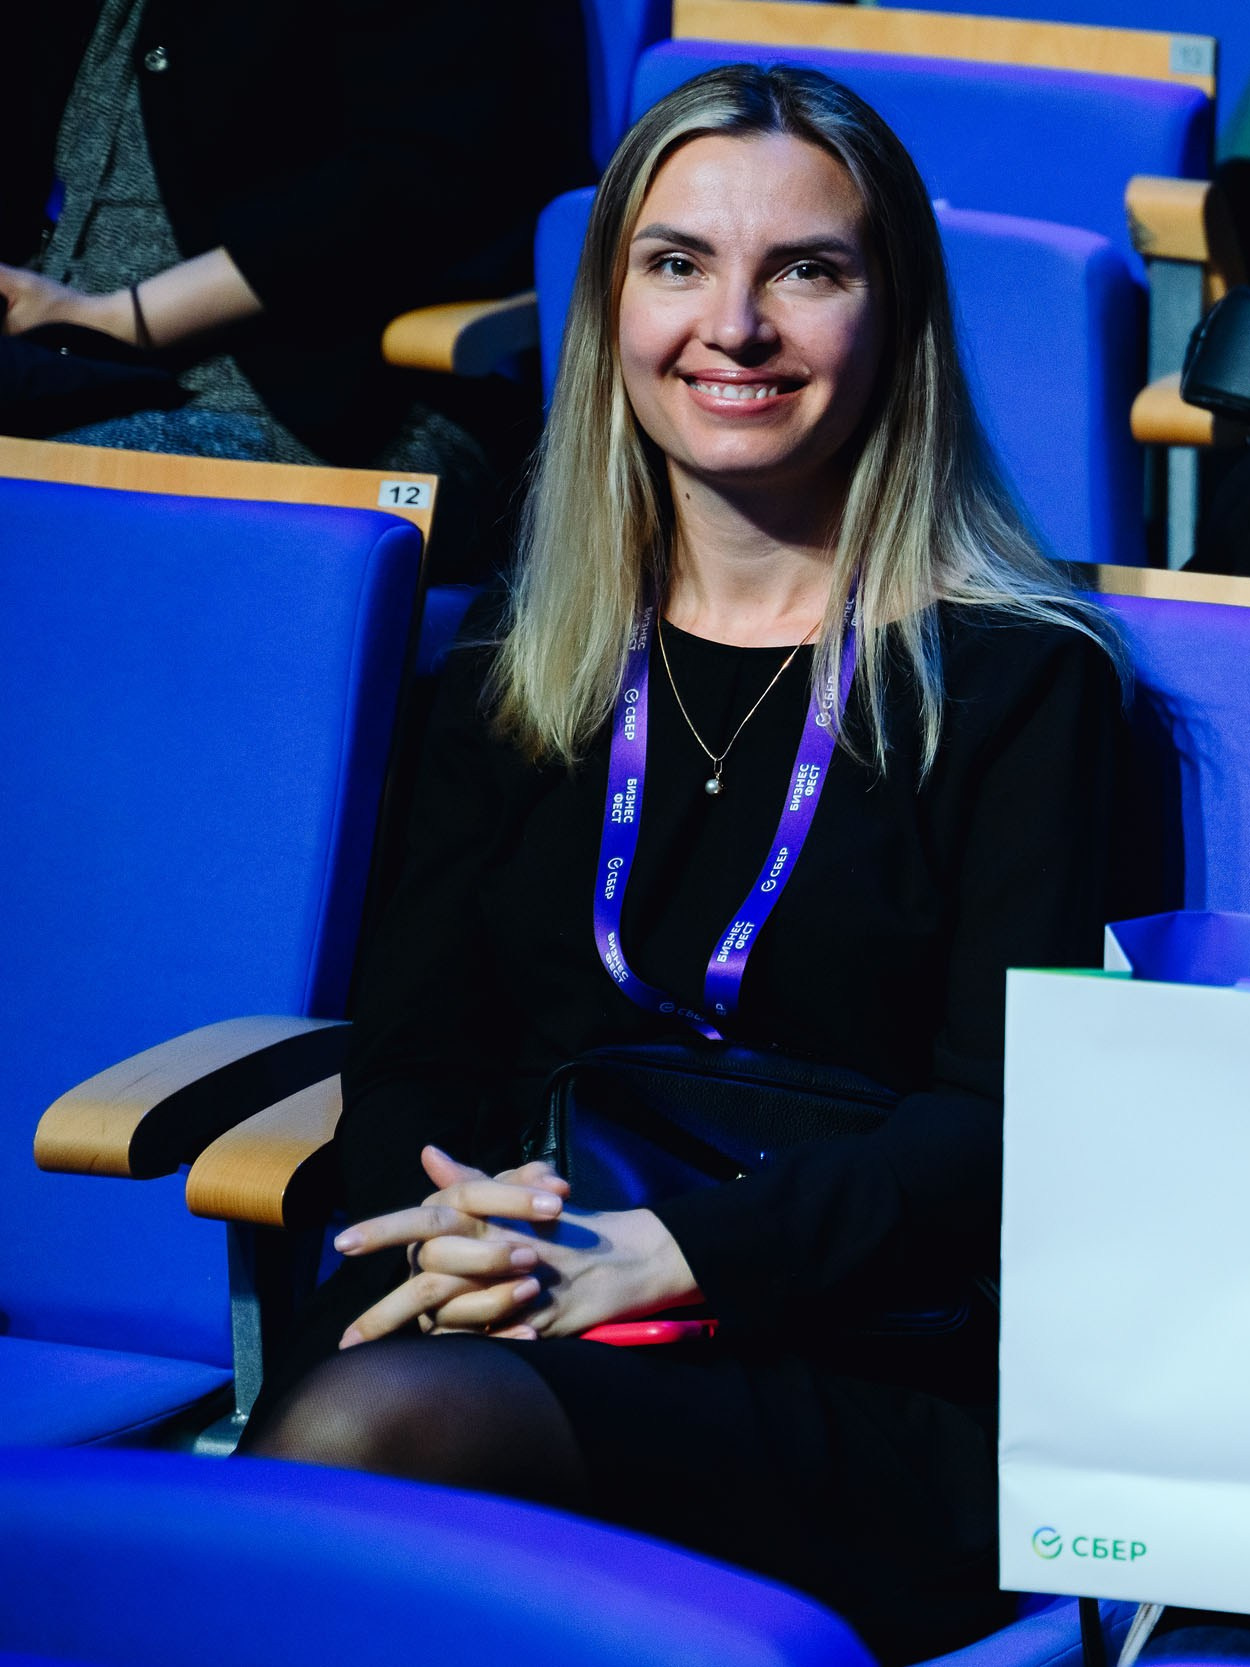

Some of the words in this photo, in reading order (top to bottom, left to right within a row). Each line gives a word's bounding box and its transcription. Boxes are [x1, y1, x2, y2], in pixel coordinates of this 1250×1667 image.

[390, 486, 420, 505] 12
[637, 606, 653, 650] БИЗНЕС
[625, 707, 636, 741] СБЕР
[789, 764, 810, 811] БИЗНЕС
[804, 765, 820, 796] ФЕСТ
[611, 793, 623, 824] ФЕСТ
[624, 778, 637, 824] БИЗНЕС
[770, 847, 788, 878] СБЕР
[604, 871, 618, 900] СБЕР
[716, 921, 745, 963] БИЗНЕС
[735, 922, 755, 950] ФЕСТ
[605, 953, 625, 984] ФЕСТ
[607, 932, 629, 980] БИЗНЕС
[1072, 1536, 1147, 1562] СБЕР
